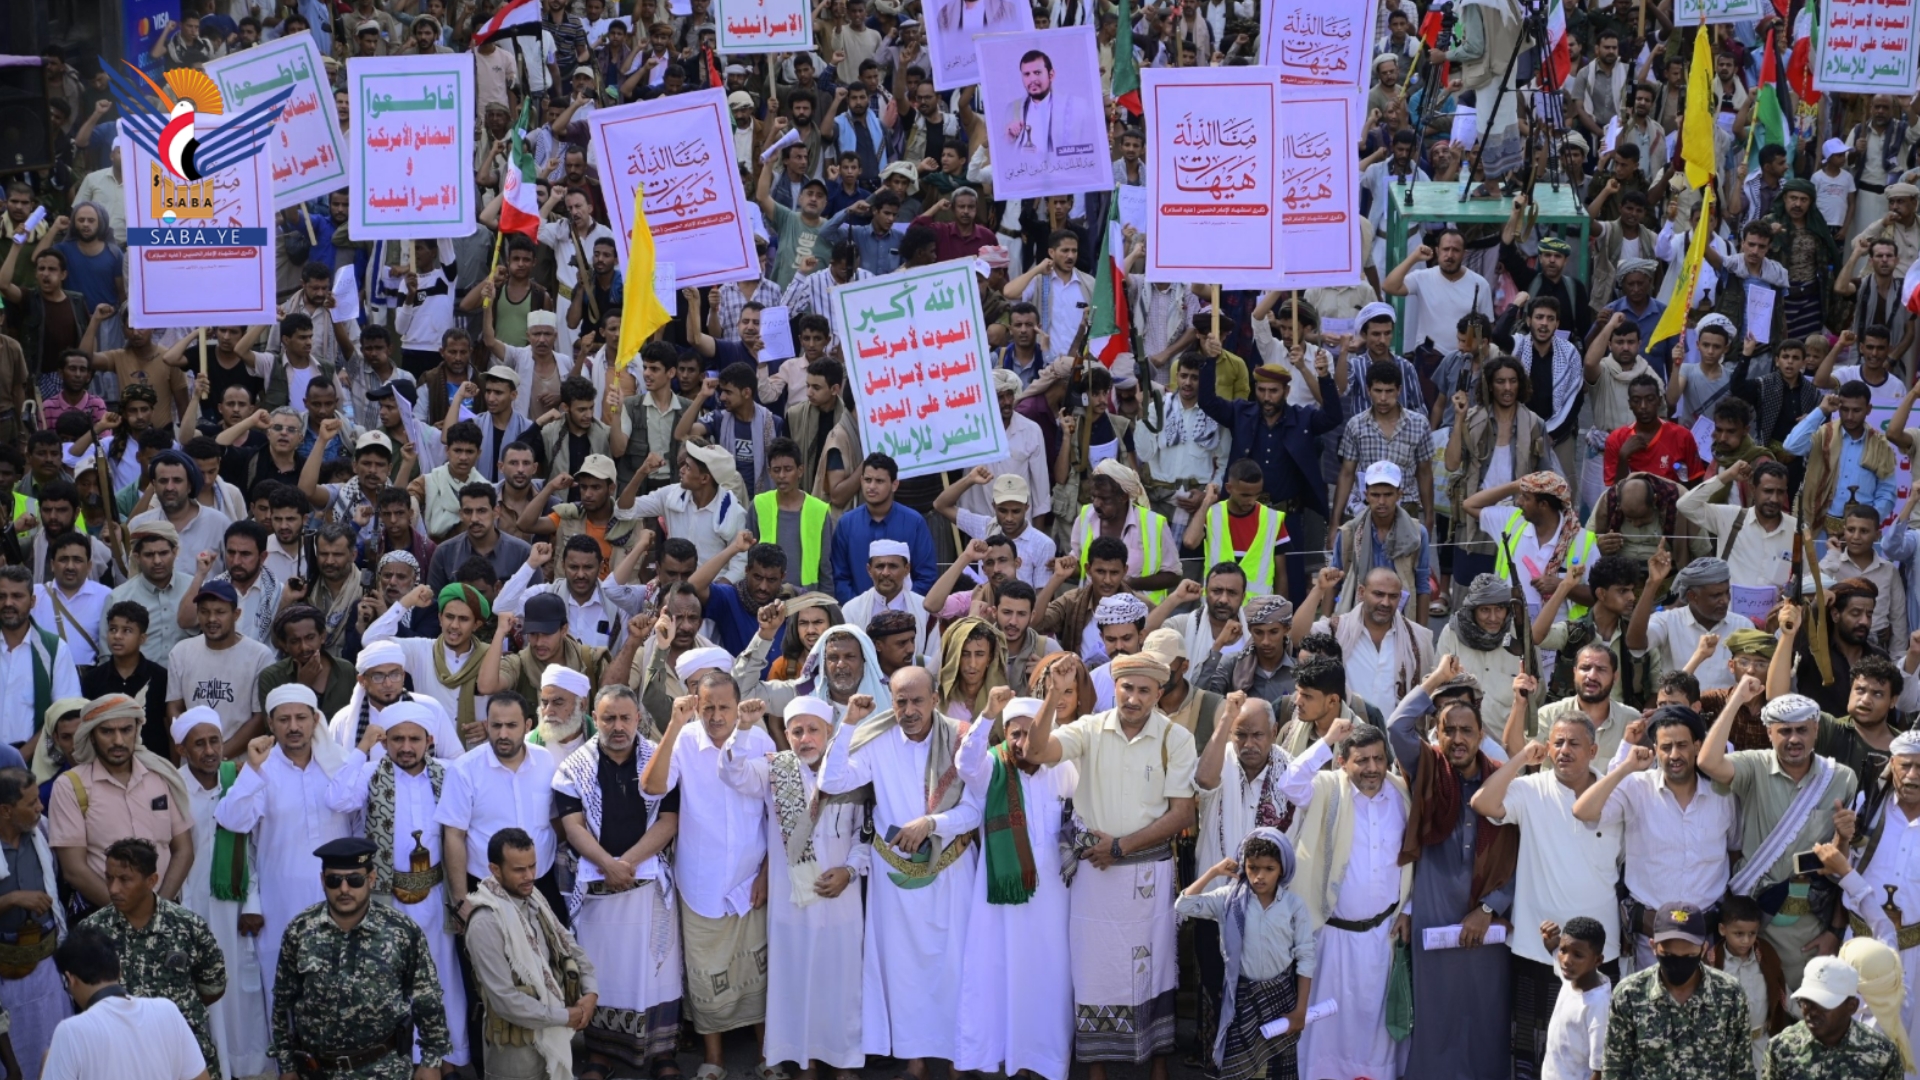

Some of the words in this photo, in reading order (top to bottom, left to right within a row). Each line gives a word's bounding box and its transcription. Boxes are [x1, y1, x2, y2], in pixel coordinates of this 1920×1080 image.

[152, 11, 170, 30] VISA
[727, 13, 802, 39] الإسرائيلية
[1830, 11, 1873, 31] لإسرائيل
[1875, 15, 1909, 31] الموت
[1828, 35, 1857, 51] اليهود
[1860, 36, 1877, 52] على
[1881, 36, 1908, 51] اللعنة
[1826, 54, 1866, 80] للإسلام
[1868, 56, 1905, 80] النصر
[226, 56, 310, 107] قاطعوا
[366, 84, 455, 119] قاطعوا
[281, 130, 288, 148] و
[367, 122, 412, 152] الأمريكية
[414, 125, 455, 151] البضائع
[272, 144, 335, 182] الإسرائيل
[406, 156, 413, 176] و
[369, 185, 457, 213] الإسرائيلية
[800, 231, 818, 241] JUST
[853, 281, 918, 334] أكبر
[924, 279, 966, 312] الله
[857, 325, 918, 359] لأمريكا
[922, 319, 972, 350] الموت
[864, 362, 924, 396] لإسرائيل
[927, 352, 977, 382] الموت
[916, 394, 940, 420] على
[944, 384, 982, 409] اللعنة
[869, 398, 912, 427] اليهود
[939, 413, 988, 454] النصر
